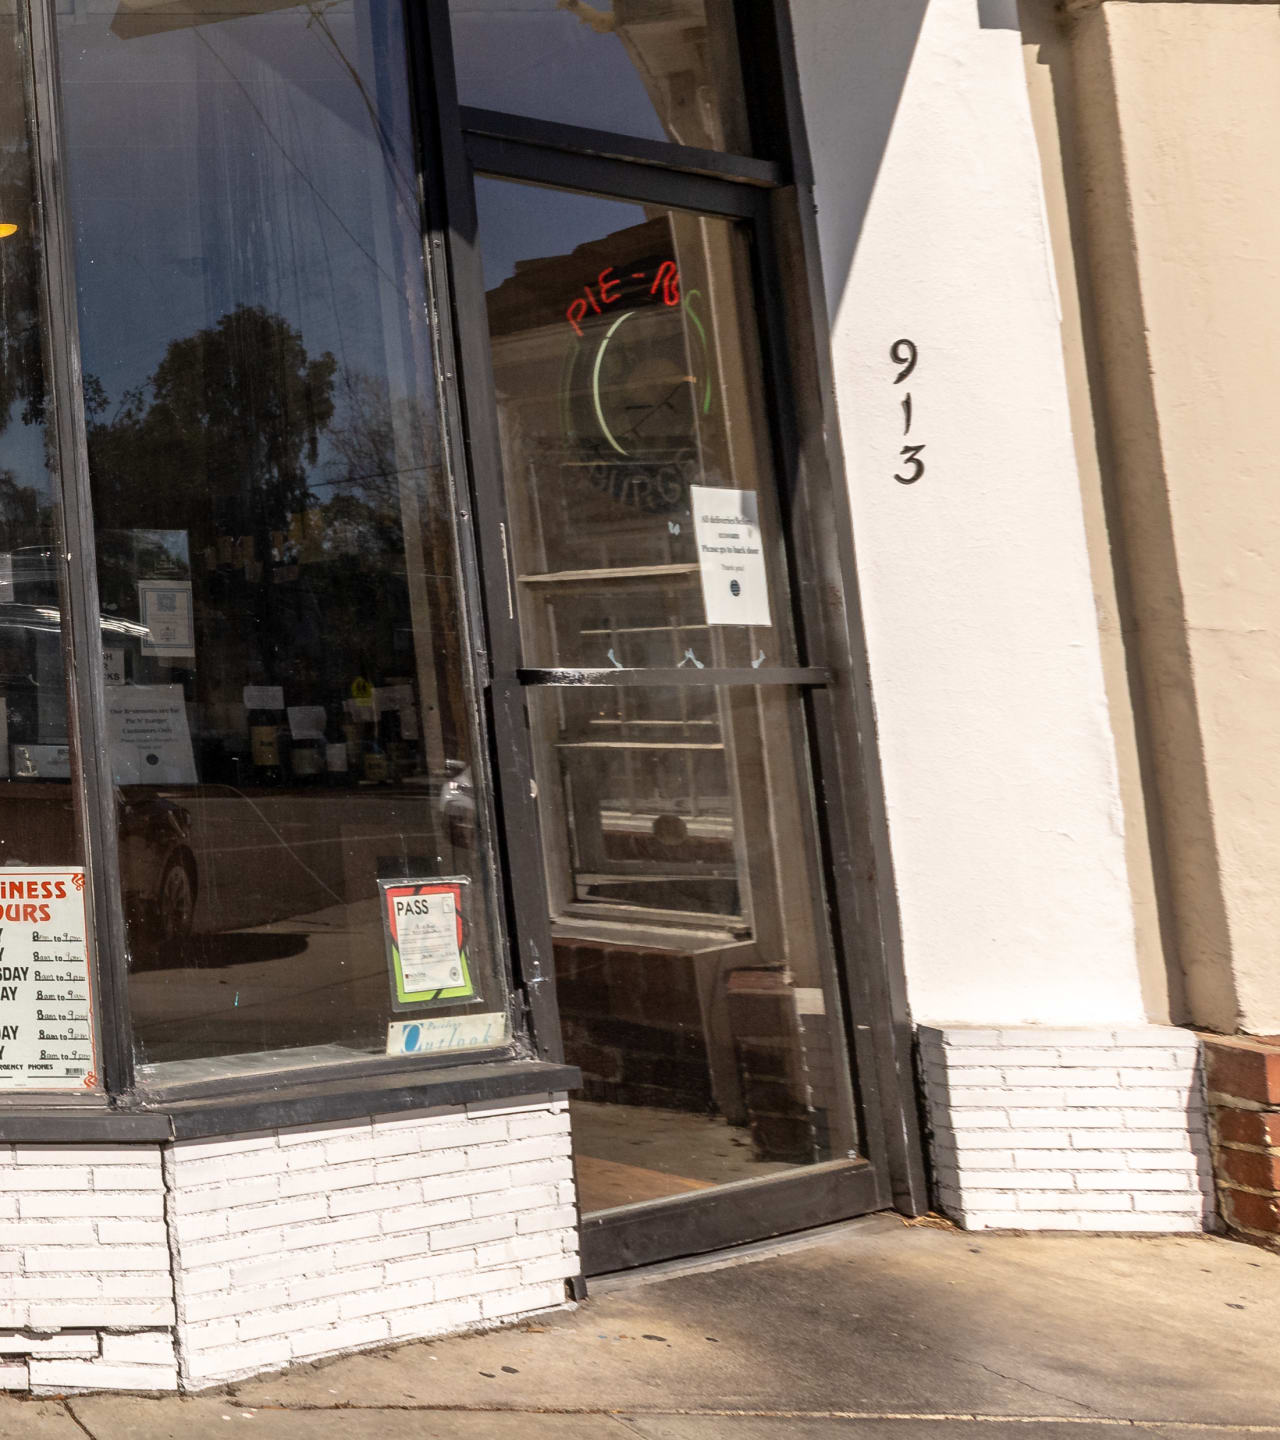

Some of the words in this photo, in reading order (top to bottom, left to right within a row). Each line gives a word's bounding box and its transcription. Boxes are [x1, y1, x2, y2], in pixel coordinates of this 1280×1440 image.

[889, 338, 927, 486] 913
[396, 899, 429, 916] PASS
[60, 1033, 68, 1041] to
[61, 1053, 69, 1061] to
[27, 1063, 54, 1071] PHONES
